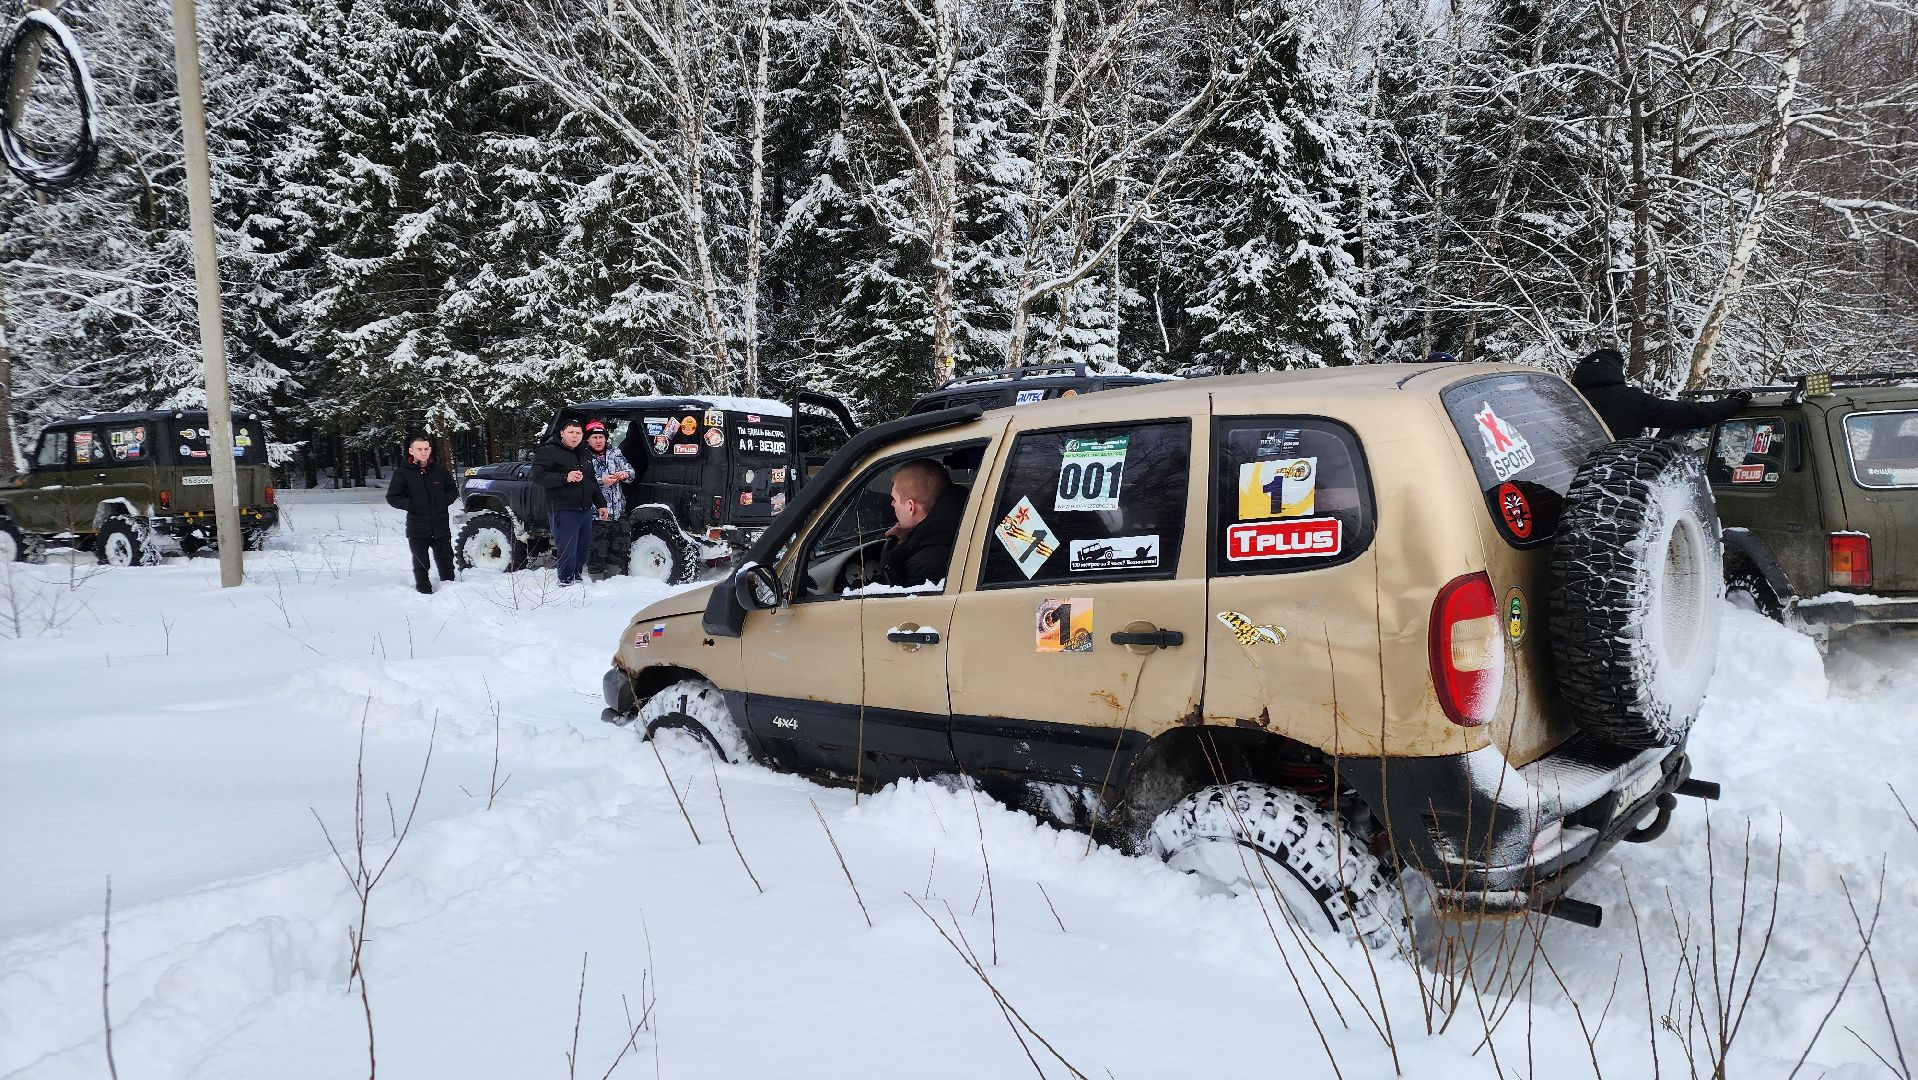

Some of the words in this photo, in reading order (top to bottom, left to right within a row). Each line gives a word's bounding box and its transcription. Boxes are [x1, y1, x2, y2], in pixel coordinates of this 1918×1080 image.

[706, 415, 723, 425] 155
[737, 426, 747, 435] ТЫ
[739, 438, 747, 450] А
[747, 438, 754, 450] Я
[1494, 444, 1533, 478] SPORT
[1734, 469, 1763, 480] TPLUS
[1060, 462, 1122, 499] 001
[1263, 475, 1284, 514] 1
[1018, 529, 1048, 564] 1
[1233, 529, 1334, 553] TPLUS
[1050, 604, 1071, 645] 1
